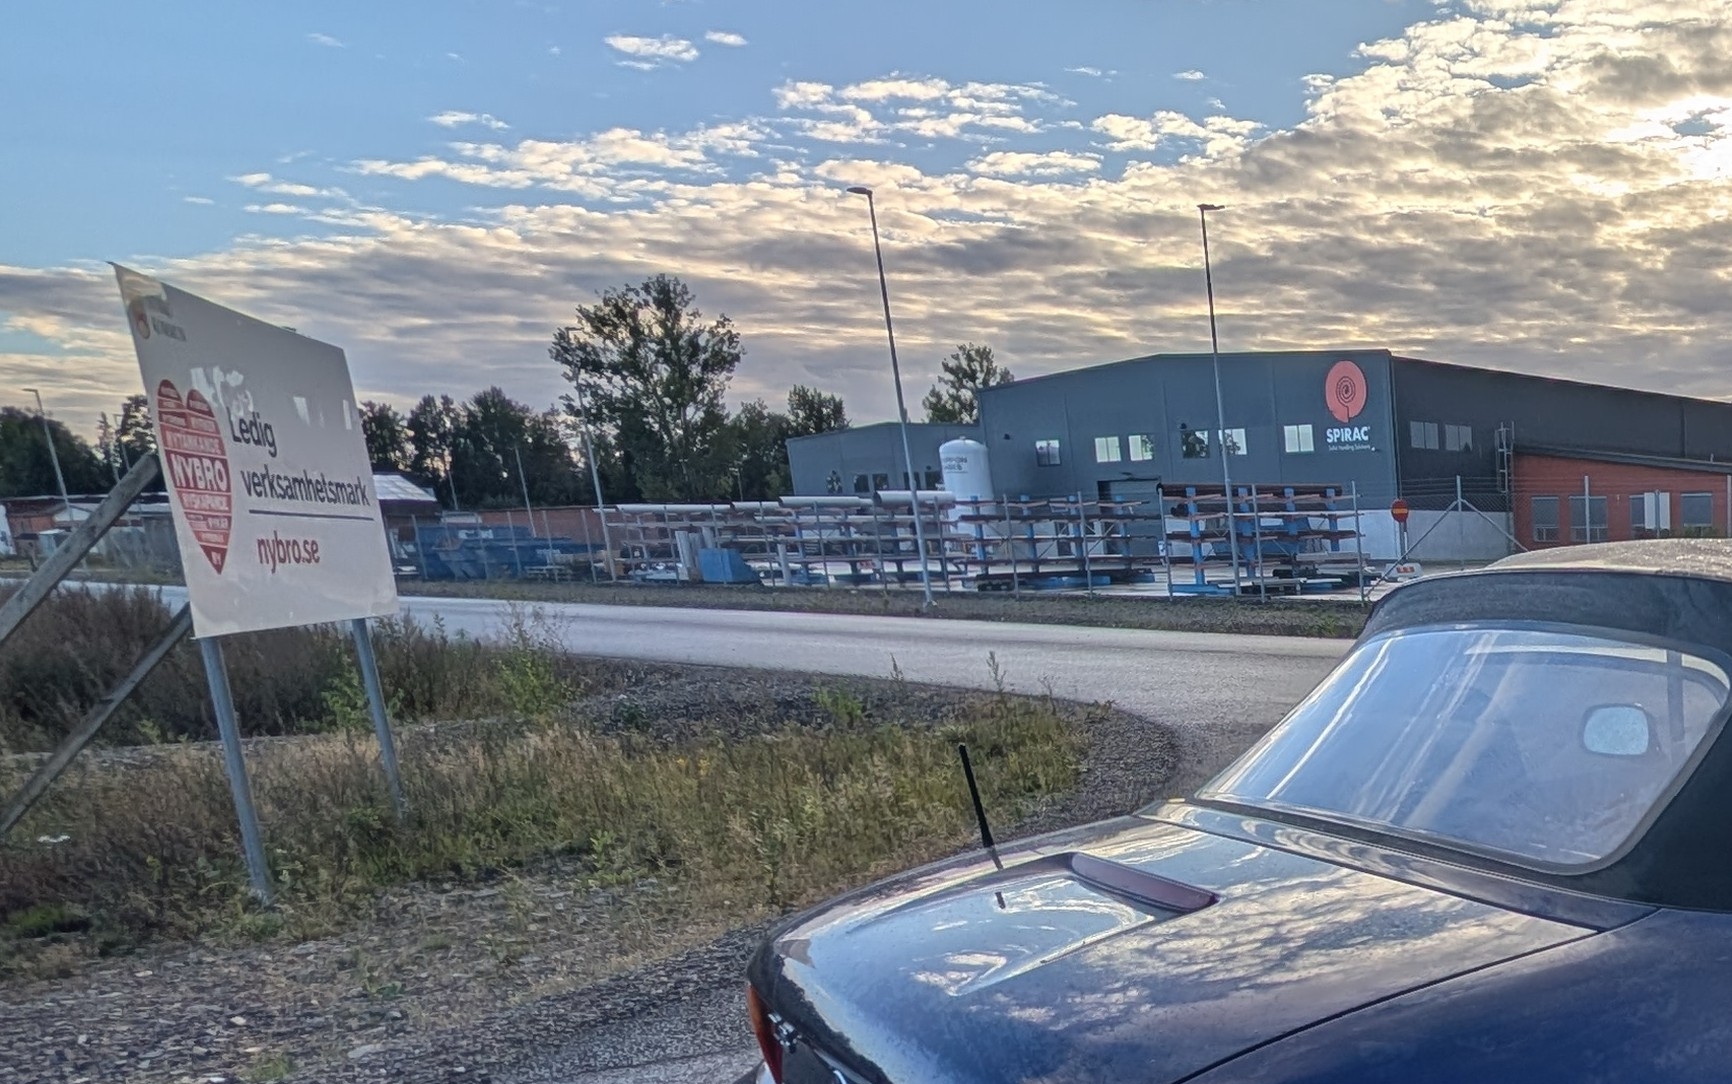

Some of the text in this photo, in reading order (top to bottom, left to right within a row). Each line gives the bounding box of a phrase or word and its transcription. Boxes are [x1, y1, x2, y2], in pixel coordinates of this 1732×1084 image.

[226, 406, 277, 457] Ledig
[1326, 426, 1369, 443] SPIRAC
[170, 453, 227, 491] NYBRO
[241, 464, 370, 506] verksamhetsmark
[257, 530, 320, 574] nybro.se
